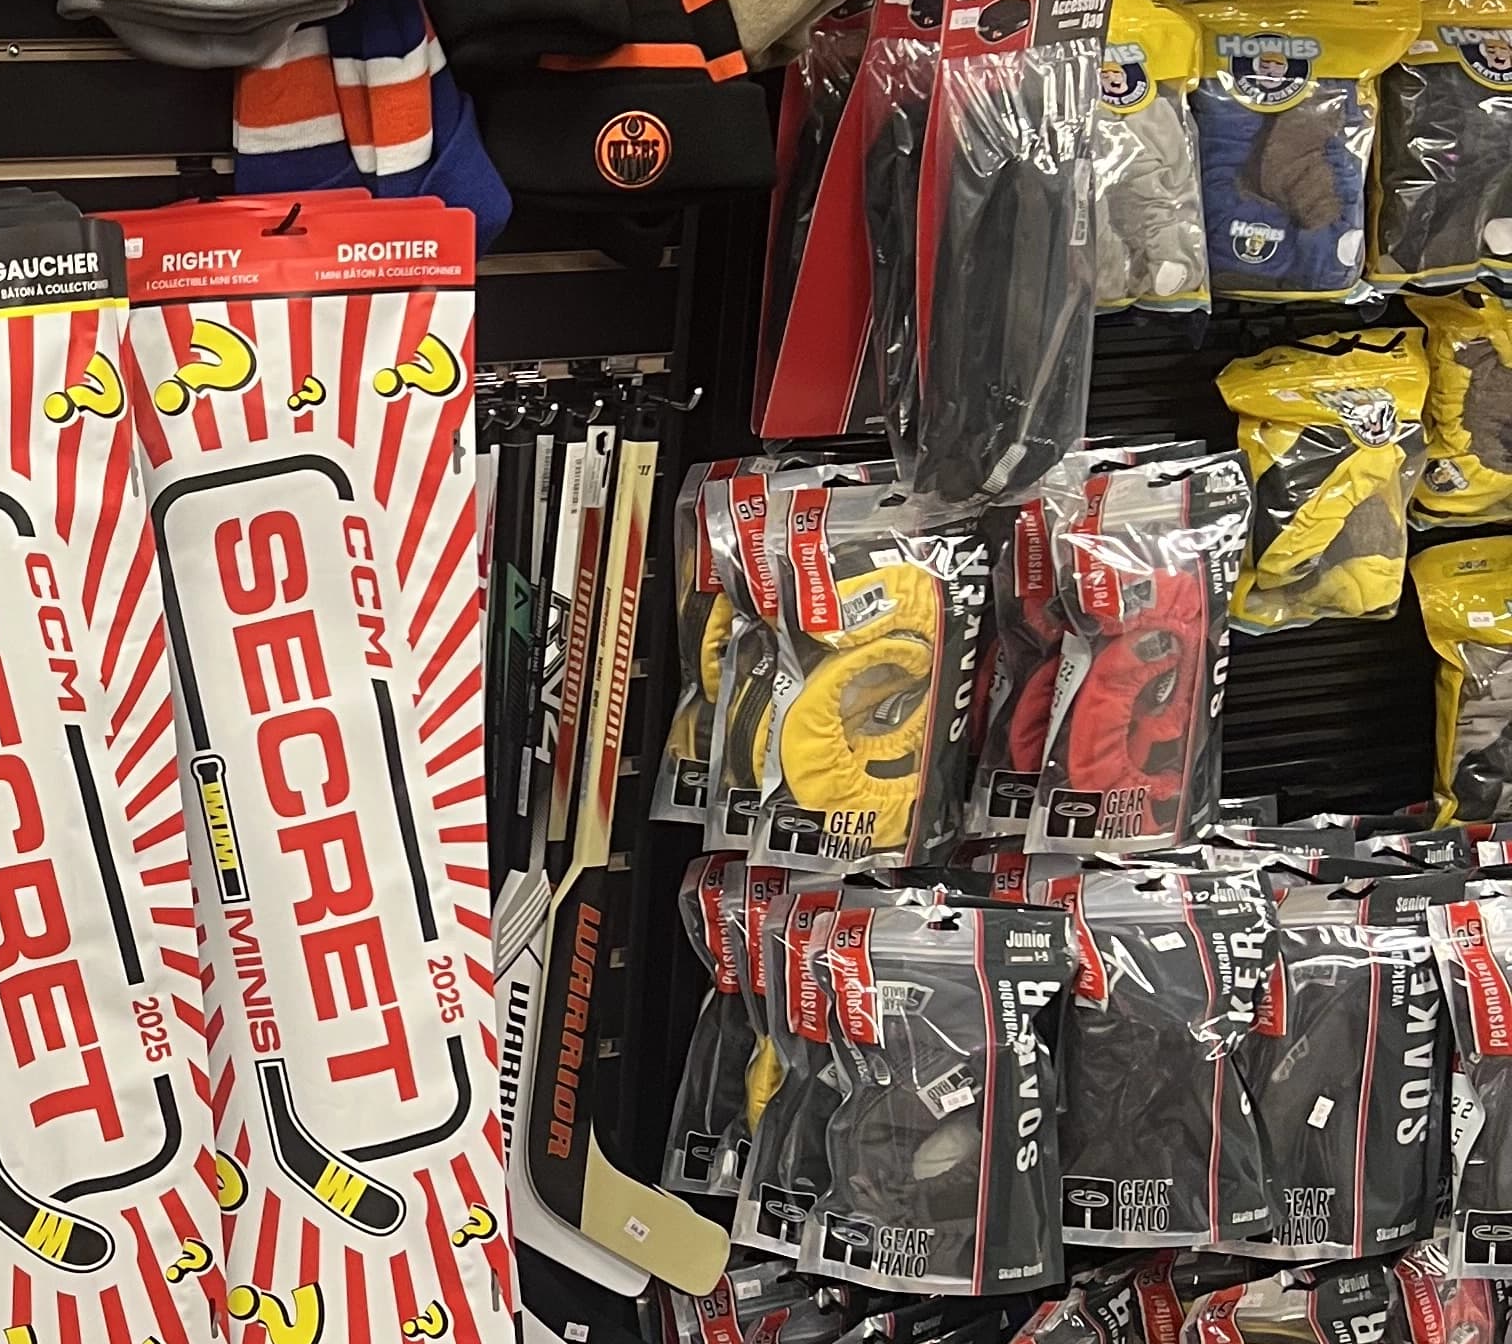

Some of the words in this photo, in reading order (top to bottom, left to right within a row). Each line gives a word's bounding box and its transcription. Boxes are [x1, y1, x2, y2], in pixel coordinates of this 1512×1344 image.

[1081, 12, 1104, 30] Bag
[1218, 35, 1322, 59] HOWIES
[1230, 219, 1285, 242] HOWIES
[162, 249, 243, 274] RIGHTY
[337, 241, 439, 263] DROITIER
[738, 495, 767, 521] 95
[794, 507, 820, 533] 95
[341, 515, 393, 672] CCM
[25, 552, 86, 713] CCM
[562, 567, 593, 726] WARRIOR
[606, 585, 636, 749] WARRIOR
[213, 509, 419, 1103] SECRET
[1106, 788, 1146, 812] GEAR
[830, 811, 877, 834] GEAR
[1101, 812, 1142, 839] HALO
[826, 834, 873, 859] HALO
[1395, 895, 1431, 913] Senior
[836, 923, 864, 950] 95
[1006, 929, 1051, 950] Junior
[224, 908, 281, 1052] MINIS
[426, 955, 464, 1024] 2025
[131, 996, 172, 1063] 2025
[547, 902, 602, 1160] WARRIOR
[1118, 1180, 1169, 1207] GEAR
[1117, 1206, 1169, 1233] HALO
[879, 1225, 929, 1254] GEAR
[877, 1254, 927, 1279] HALO
[1337, 1272, 1370, 1295] Senior
[701, 1290, 729, 1319] 95
